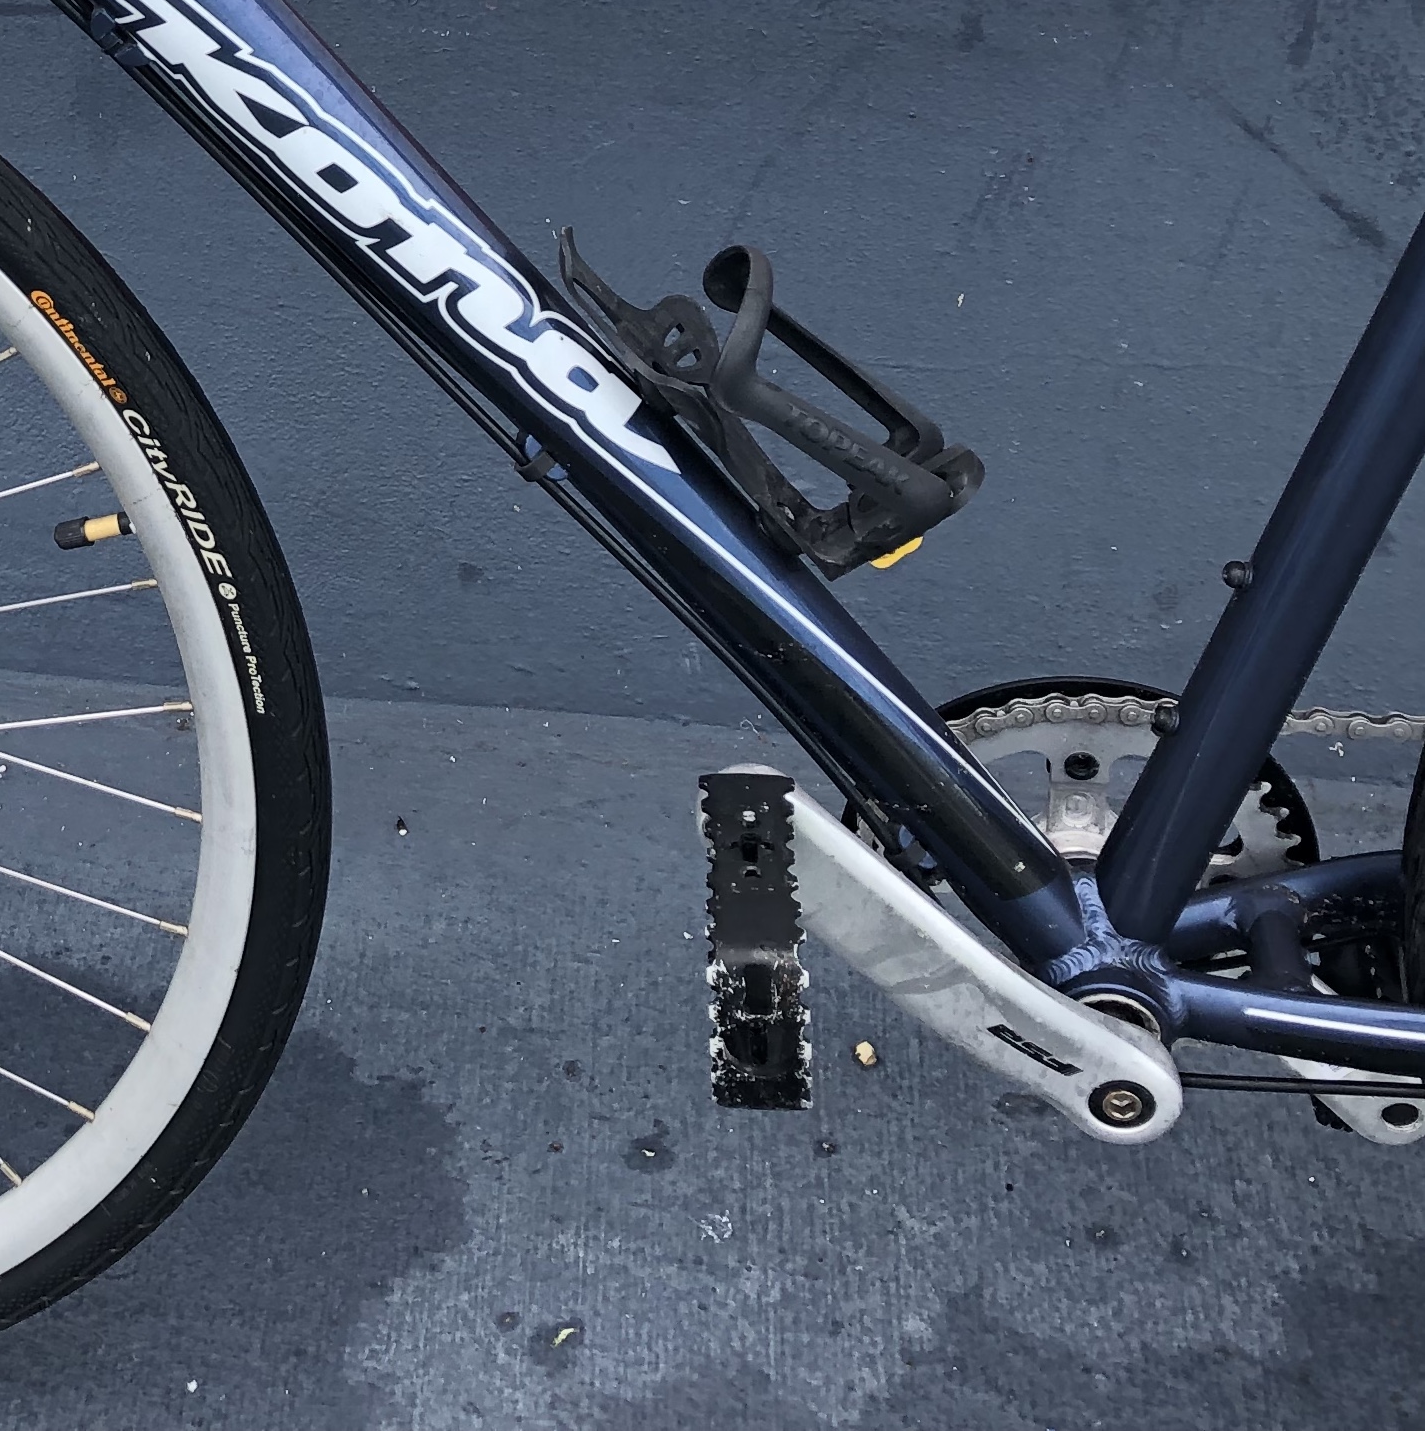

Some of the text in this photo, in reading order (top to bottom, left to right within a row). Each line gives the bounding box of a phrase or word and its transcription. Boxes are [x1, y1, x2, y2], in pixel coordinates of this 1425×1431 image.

[30, 289, 117, 388] Continental
[122, 408, 232, 580] CityRIDE
[784, 402, 910, 495] TOPEAK
[227, 603, 253, 655] Puncture
